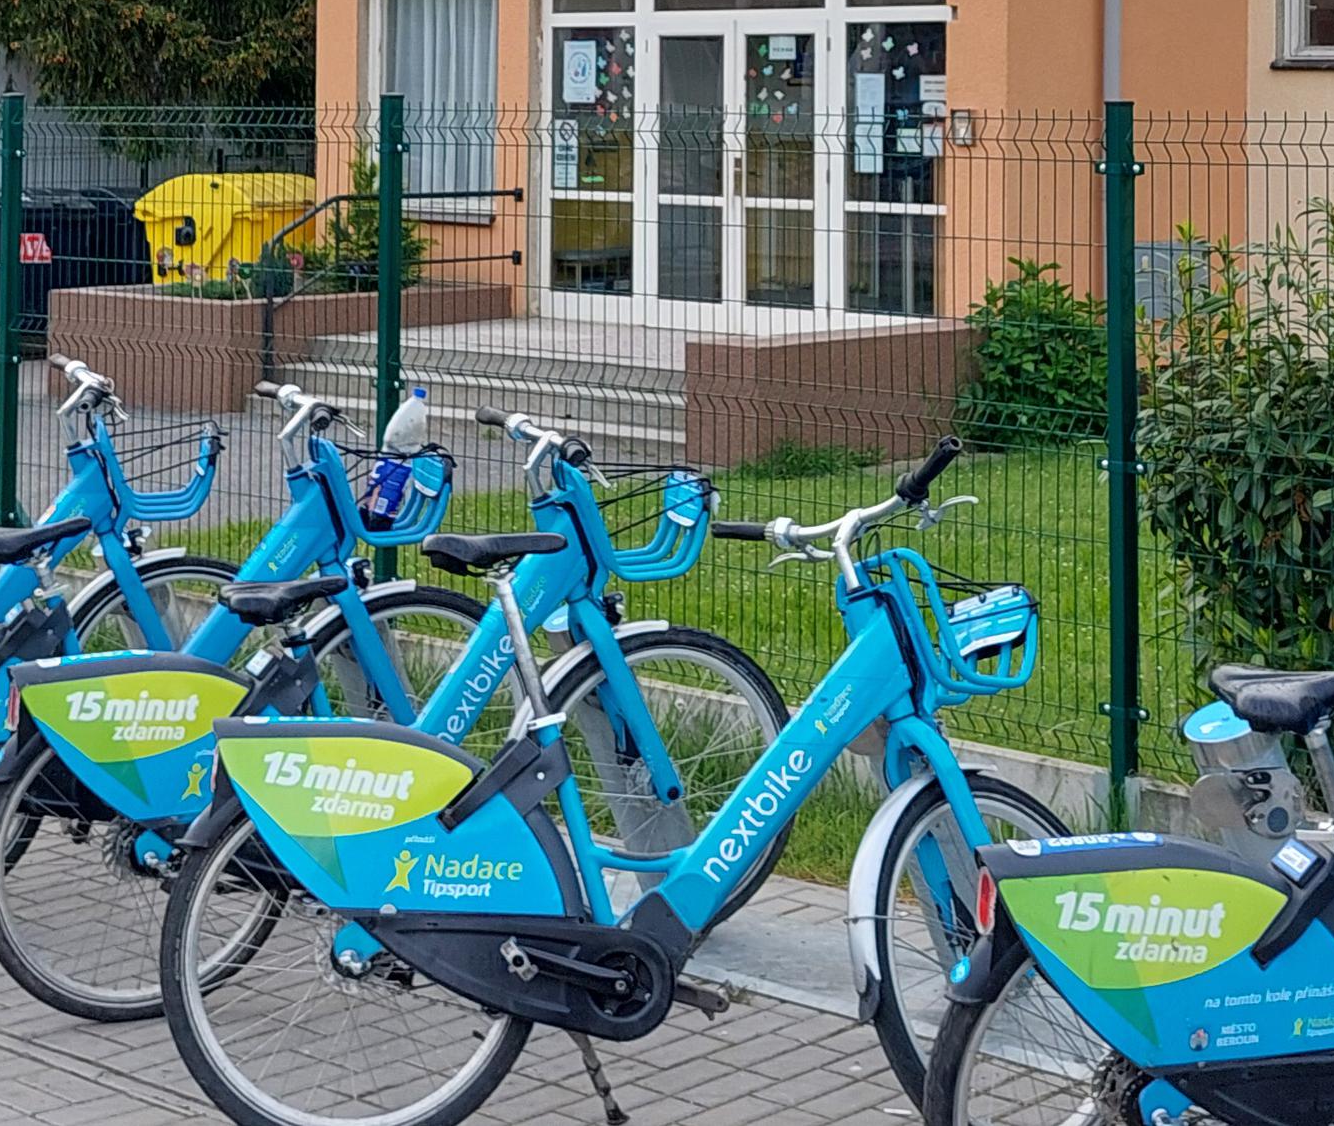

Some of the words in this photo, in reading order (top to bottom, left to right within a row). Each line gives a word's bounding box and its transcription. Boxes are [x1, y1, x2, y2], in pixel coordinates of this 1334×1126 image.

[66, 690, 105, 722] 15
[102, 690, 200, 722] minut
[112, 722, 186, 741] zdarma
[263, 750, 307, 786] 15
[302, 758, 414, 800] minut
[311, 793, 394, 821] zdarma
[703, 749, 813, 882] nextbike
[425, 853, 523, 880] Nadace
[423, 879, 492, 900] Tipsport
[1054, 890, 1105, 932] 15
[1103, 895, 1225, 939] minut
[1115, 938, 1207, 964] zdarma
[1204, 998, 1221, 1009] na
[1224, 993, 1262, 1007] tomto
[1216, 1034, 1259, 1047] BEROUN
